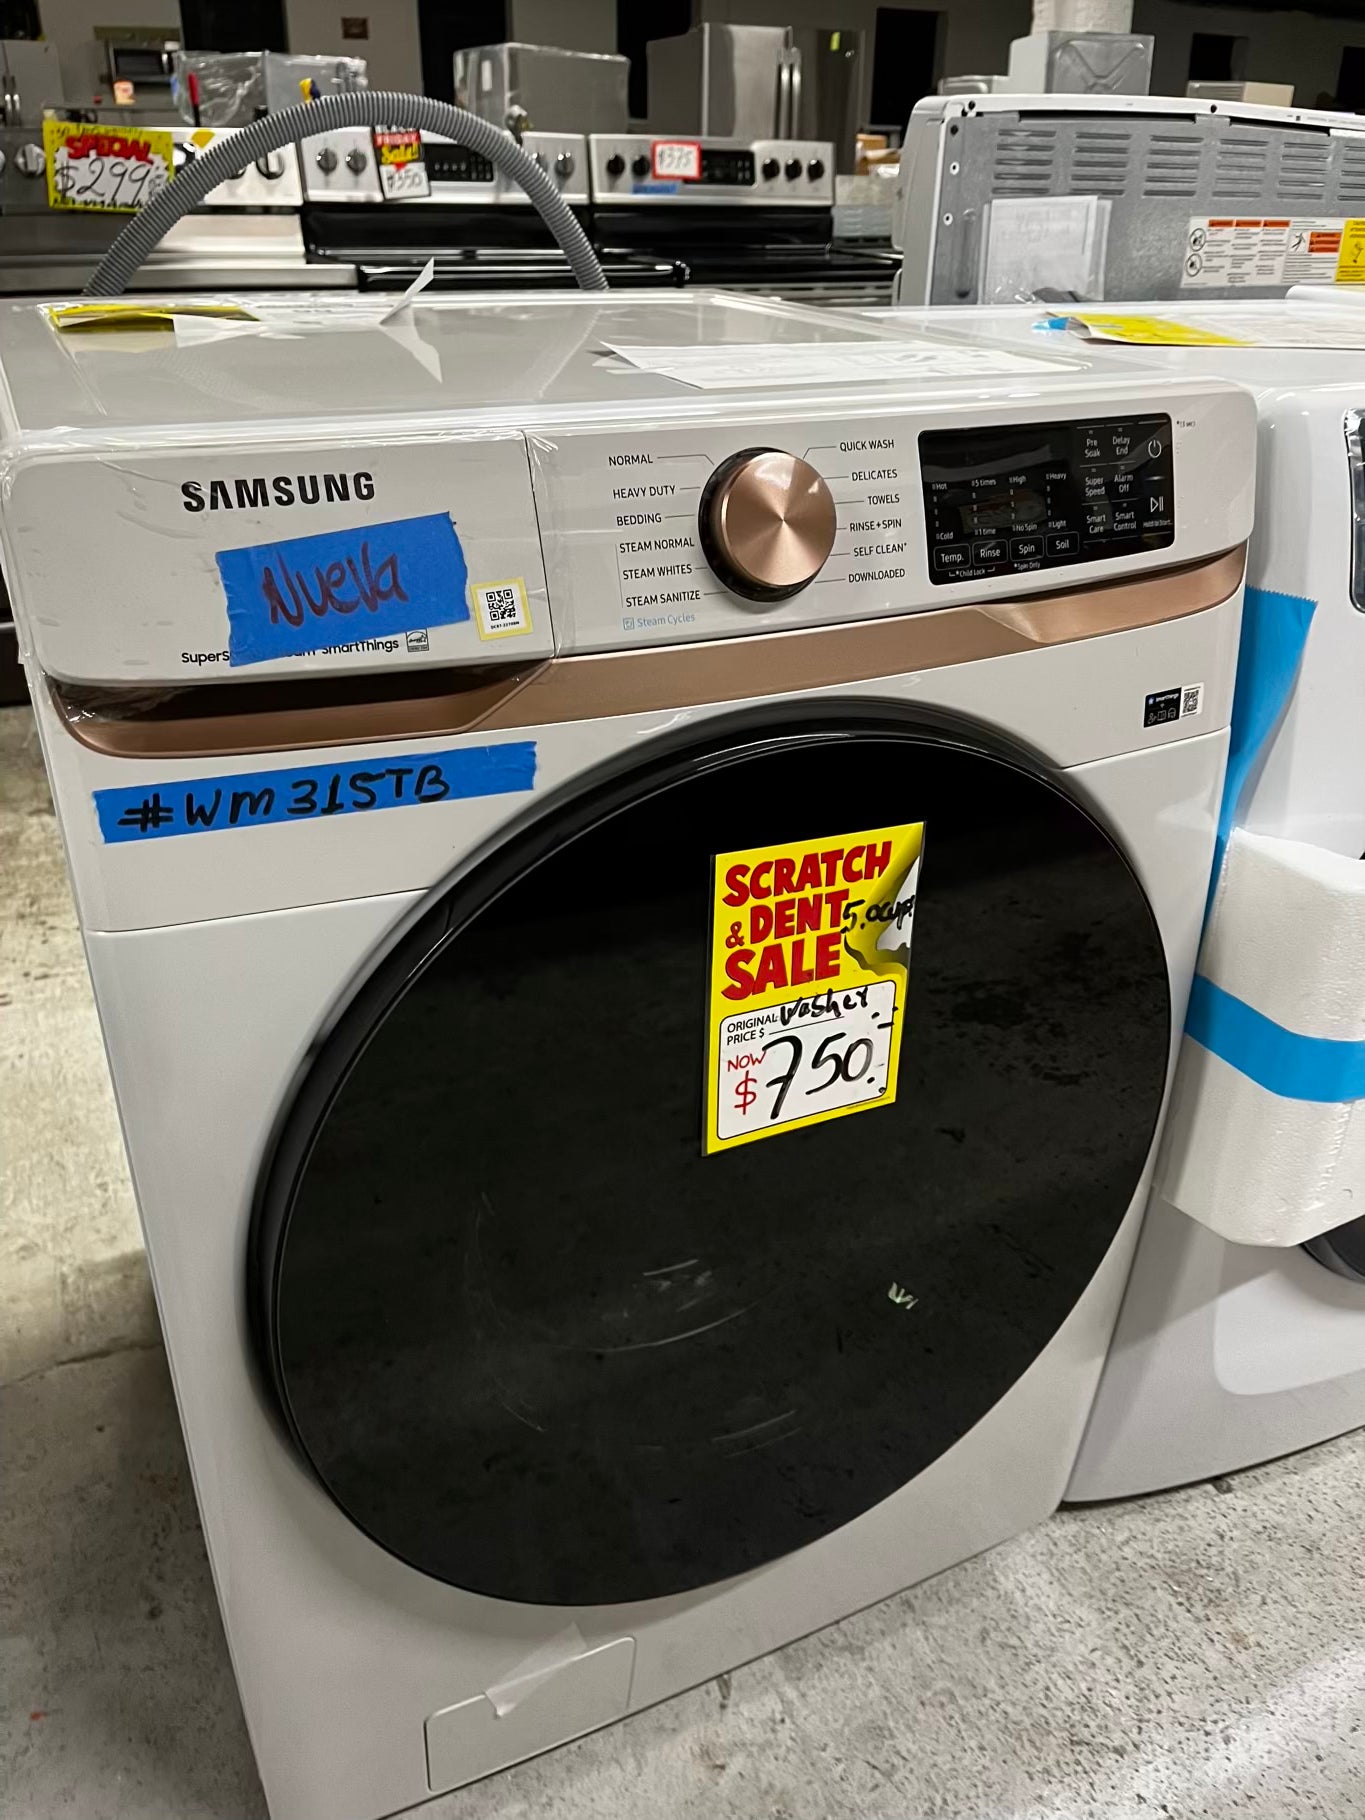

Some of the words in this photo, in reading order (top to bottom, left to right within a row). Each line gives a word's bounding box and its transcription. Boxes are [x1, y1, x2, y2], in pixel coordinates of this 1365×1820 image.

[840, 440, 867, 453] QUICK
[868, 439, 895, 450] WASH
[1112, 436, 1131, 447] Delay
[608, 454, 654, 467] NORMAL
[851, 468, 898, 482] DELICATES
[1085, 477, 1104, 487] Super
[1113, 474, 1134, 483] Alarm
[181, 472, 375, 512] SAMSUNG
[613, 486, 646, 500] HEAVY
[649, 485, 676, 497] DUTY
[1085, 486, 1106, 497] Speed
[867, 493, 900, 506] TOWELS
[616, 512, 662, 527] BEDDING
[1086, 514, 1106, 524] Smart
[1115, 511, 1135, 521] Smart
[849, 520, 876, 533] RINSE
[882, 517, 903, 530] SPIN
[1089, 525, 1104, 535] Care
[1113, 521, 1137, 532] Control
[619, 540, 652, 554] STEAM
[654, 537, 695, 551] NORMAL
[853, 545, 874, 558] SELF
[1018, 543, 1035, 555] Spin
[1055, 539, 1070, 550] Soil
[941, 553, 964, 564] Temp.
[980, 548, 1001, 559] Rinse
[622, 568, 655, 581] STEAM
[657, 564, 692, 577] WHITES
[848, 568, 905, 583] DOWNLOADED
[626, 594, 658, 608] STEAM
[660, 590, 701, 604] SANITIZE
[637, 617, 666, 629] Steam
[667, 612, 696, 625] Cycles
[181, 650, 230, 667] SuperS
[722, 840, 893, 907] SCRATCH
[750, 888, 850, 945] DENT
[721, 932, 842, 1001] SALE
[727, 1013, 778, 1035] ORIGINAL
[727, 1033, 757, 1046] PRICE
[727, 1050, 767, 1073] NOW
